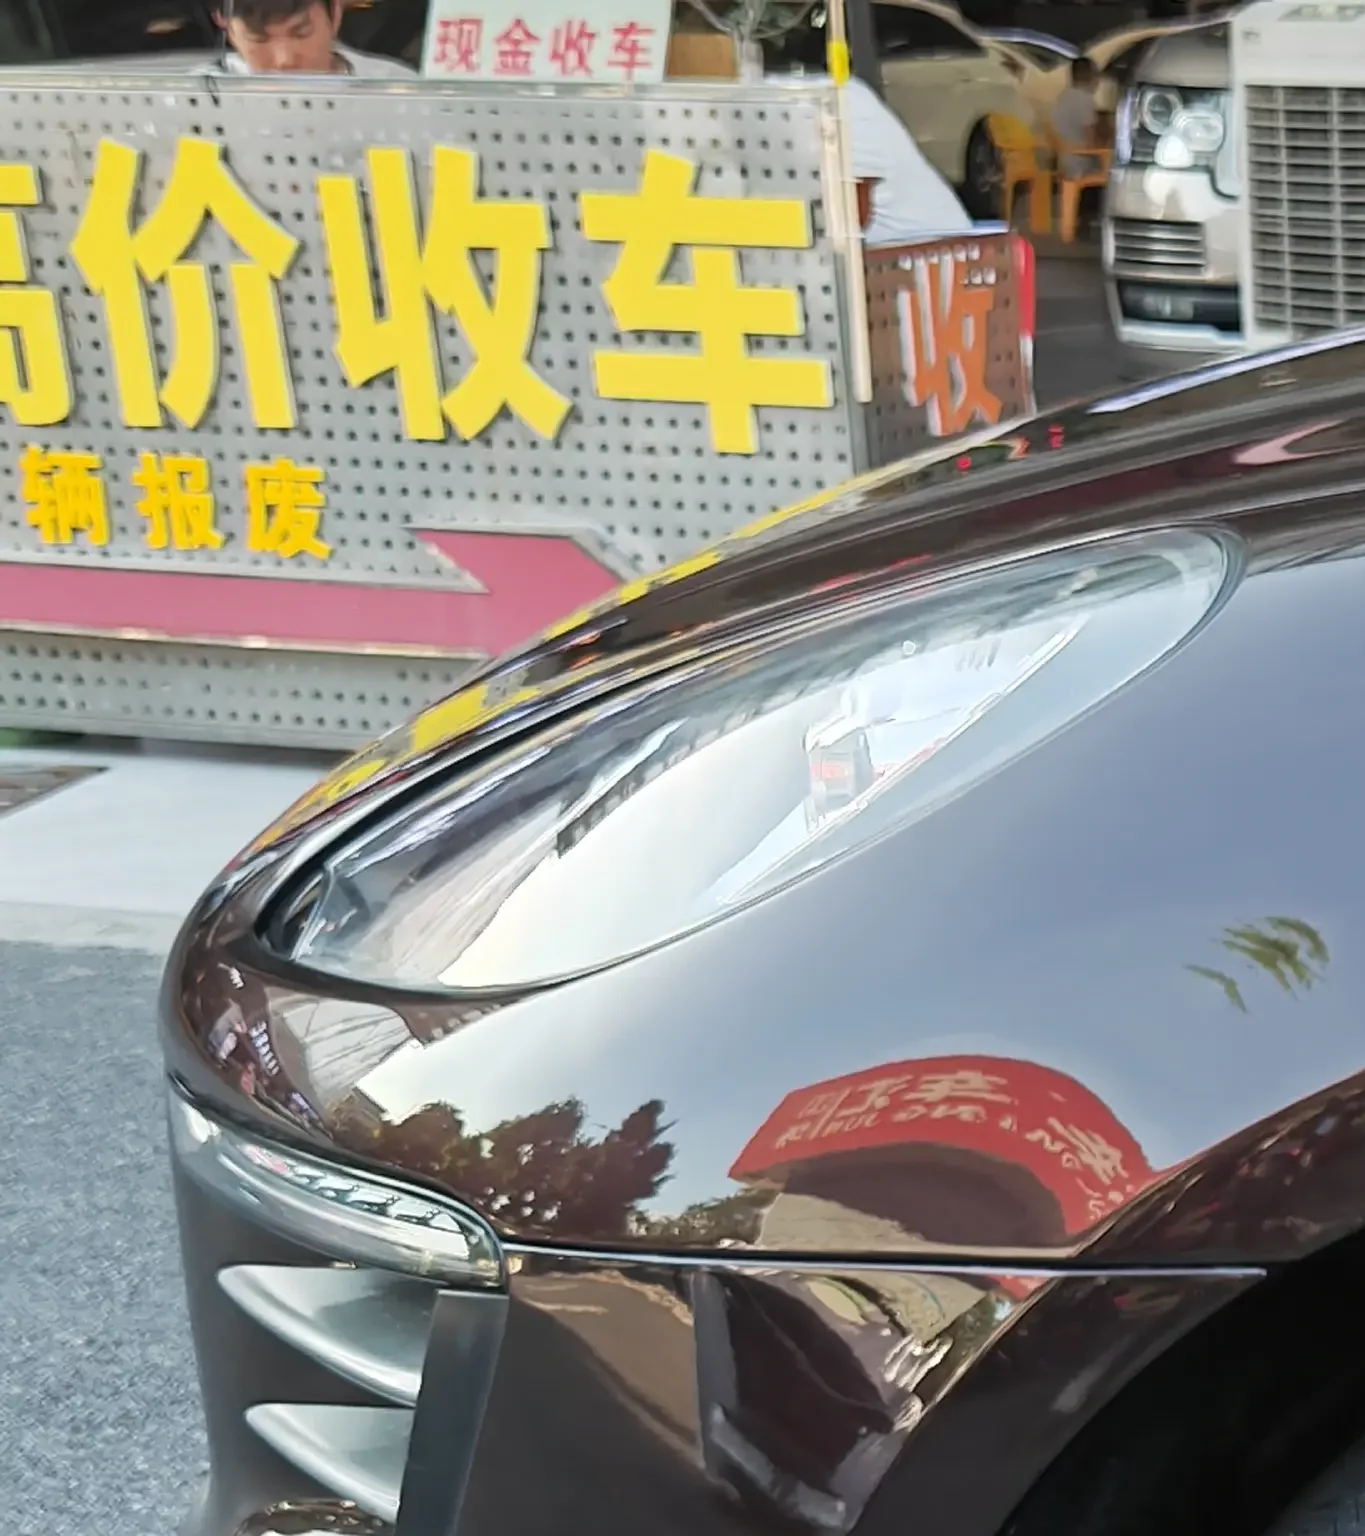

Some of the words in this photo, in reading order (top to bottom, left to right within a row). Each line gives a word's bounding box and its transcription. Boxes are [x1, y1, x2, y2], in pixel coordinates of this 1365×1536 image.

[433, 17, 656, 84] 现金收车
[18, 445, 333, 560] 辆报废
